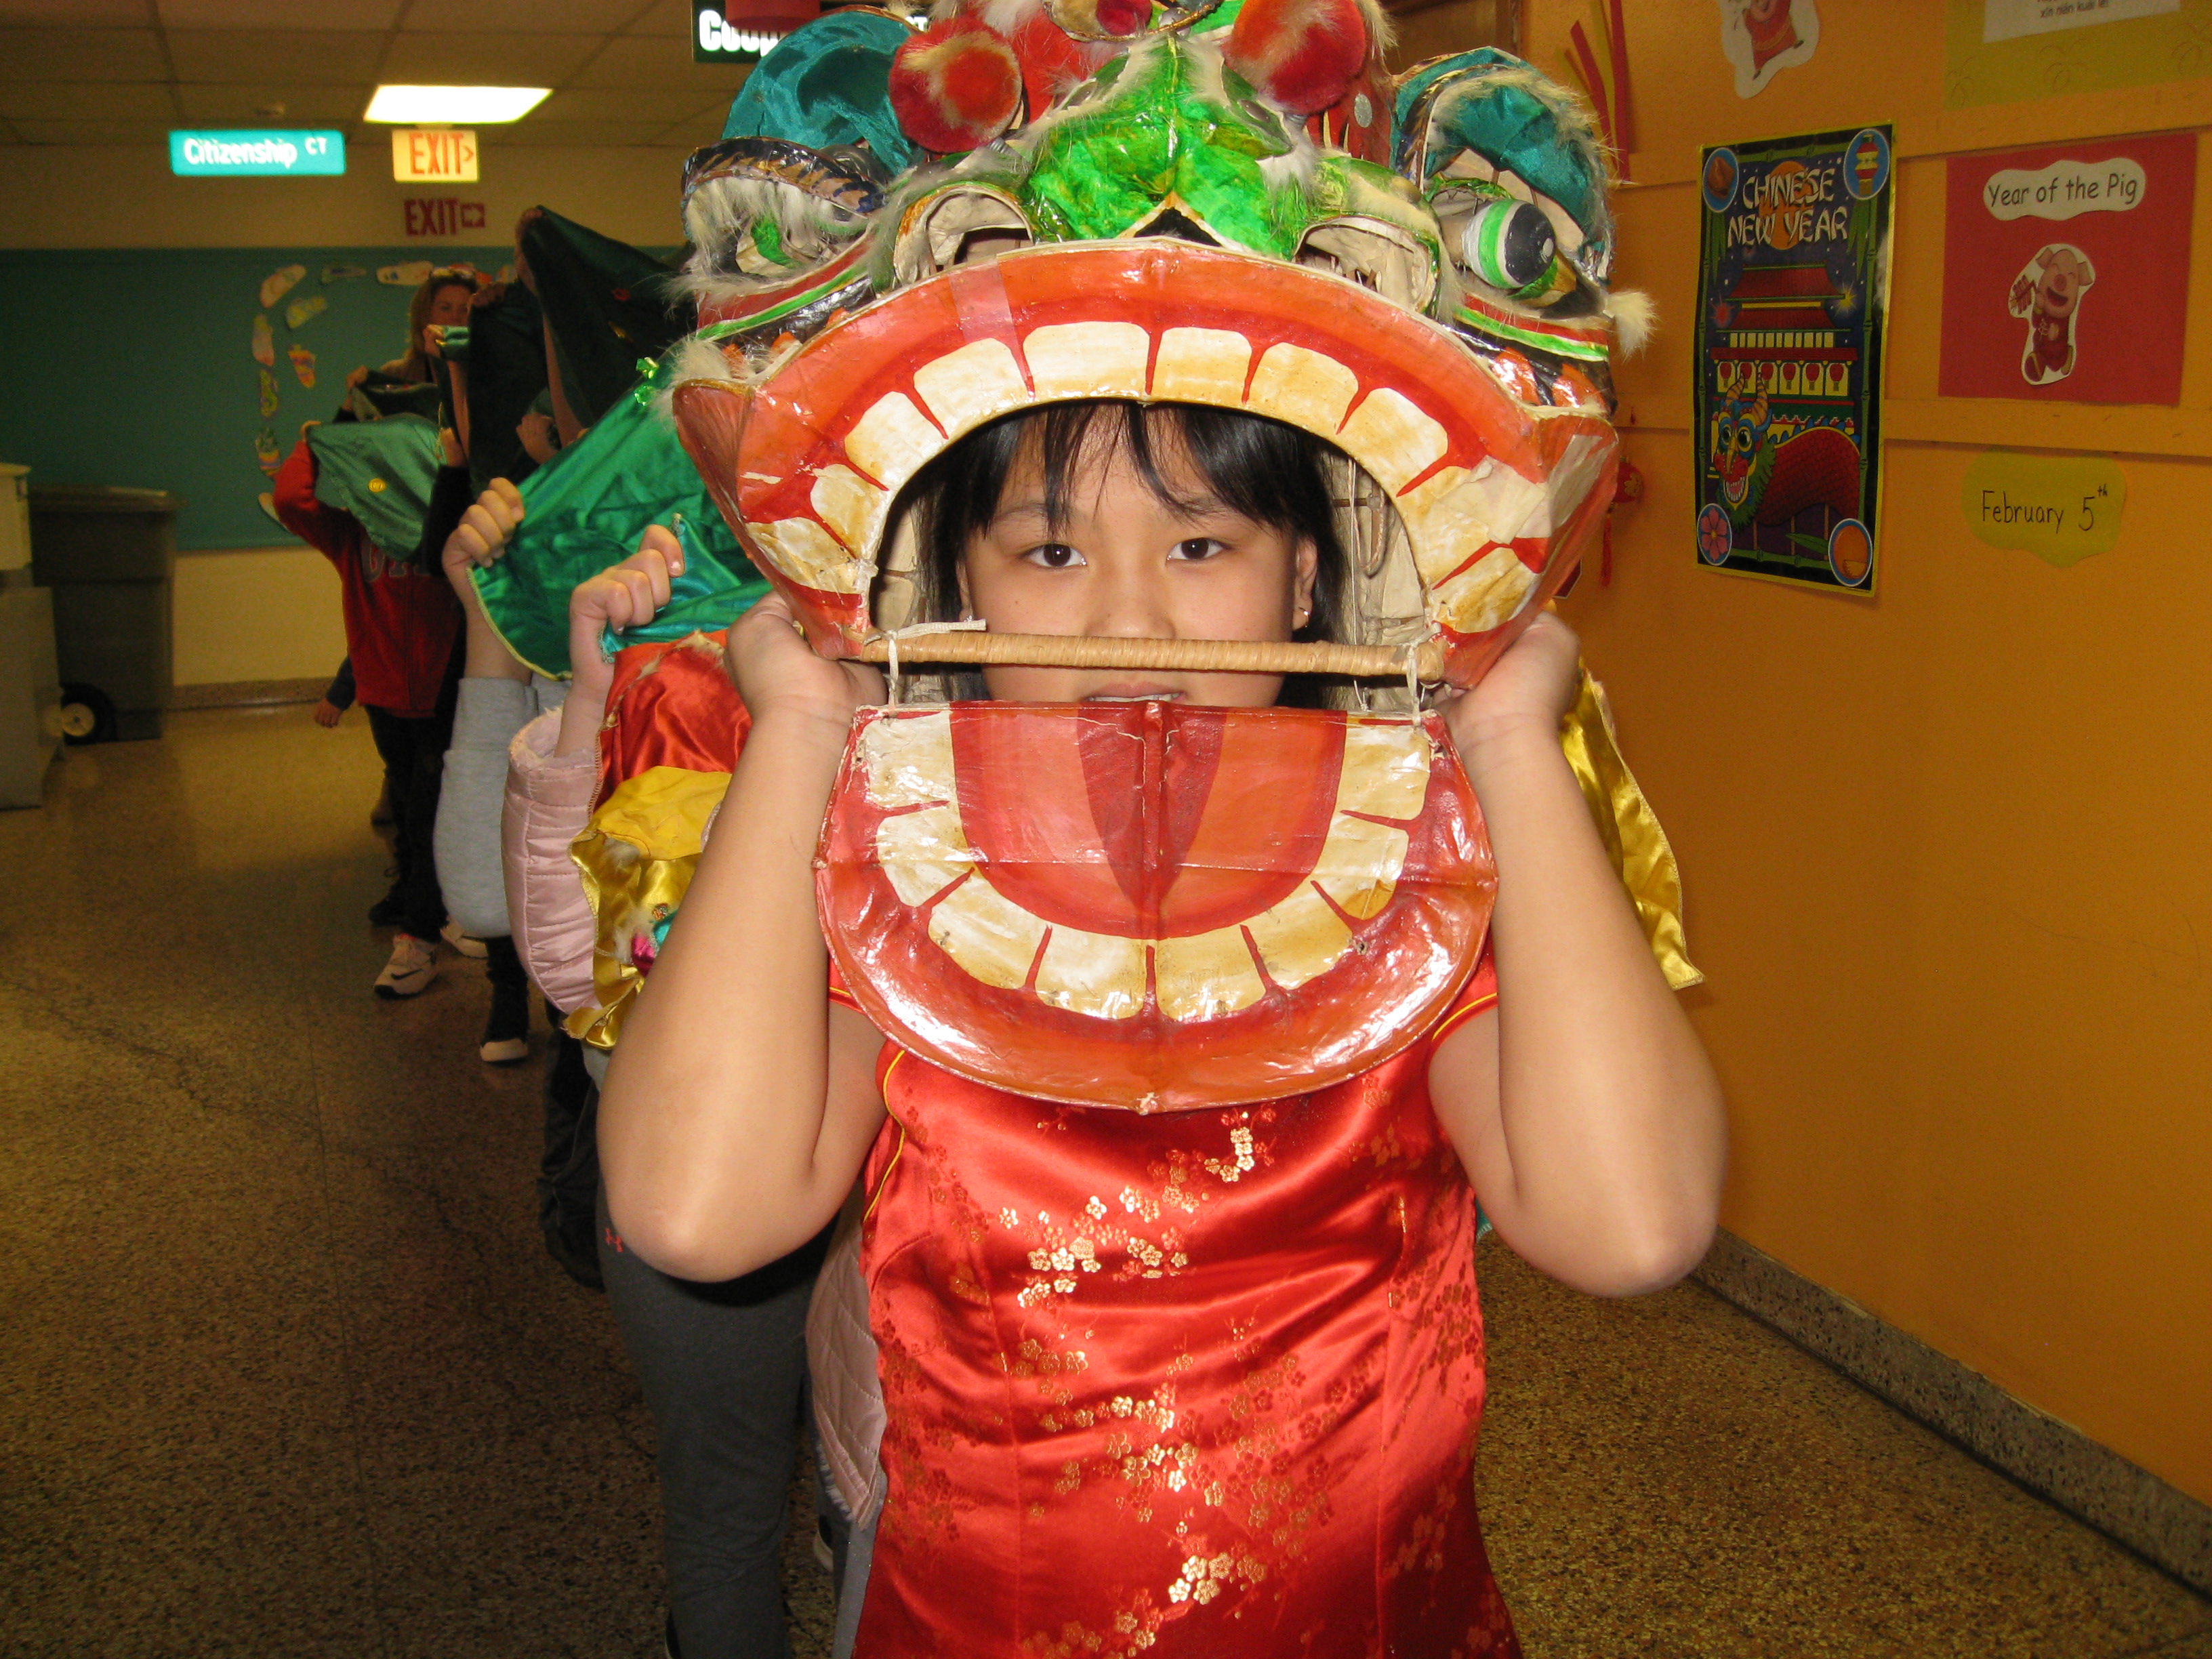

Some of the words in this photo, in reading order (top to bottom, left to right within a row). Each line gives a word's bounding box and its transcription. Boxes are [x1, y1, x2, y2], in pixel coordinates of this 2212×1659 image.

[184, 138, 298, 169] Citizenship
[306, 138, 327, 155] CT
[409, 133, 464, 174] EXIT
[1743, 169, 1835, 209] CHINESE
[1988, 184, 2030, 207] Year
[2036, 177, 2058, 203] of
[2065, 175, 2099, 201] the
[2106, 173, 2137, 205] Pig
[405, 197, 459, 236] EXIT
[1727, 213, 1776, 248] NEW
[1784, 206, 1848, 246] YEAR
[1982, 490, 2064, 534] February
